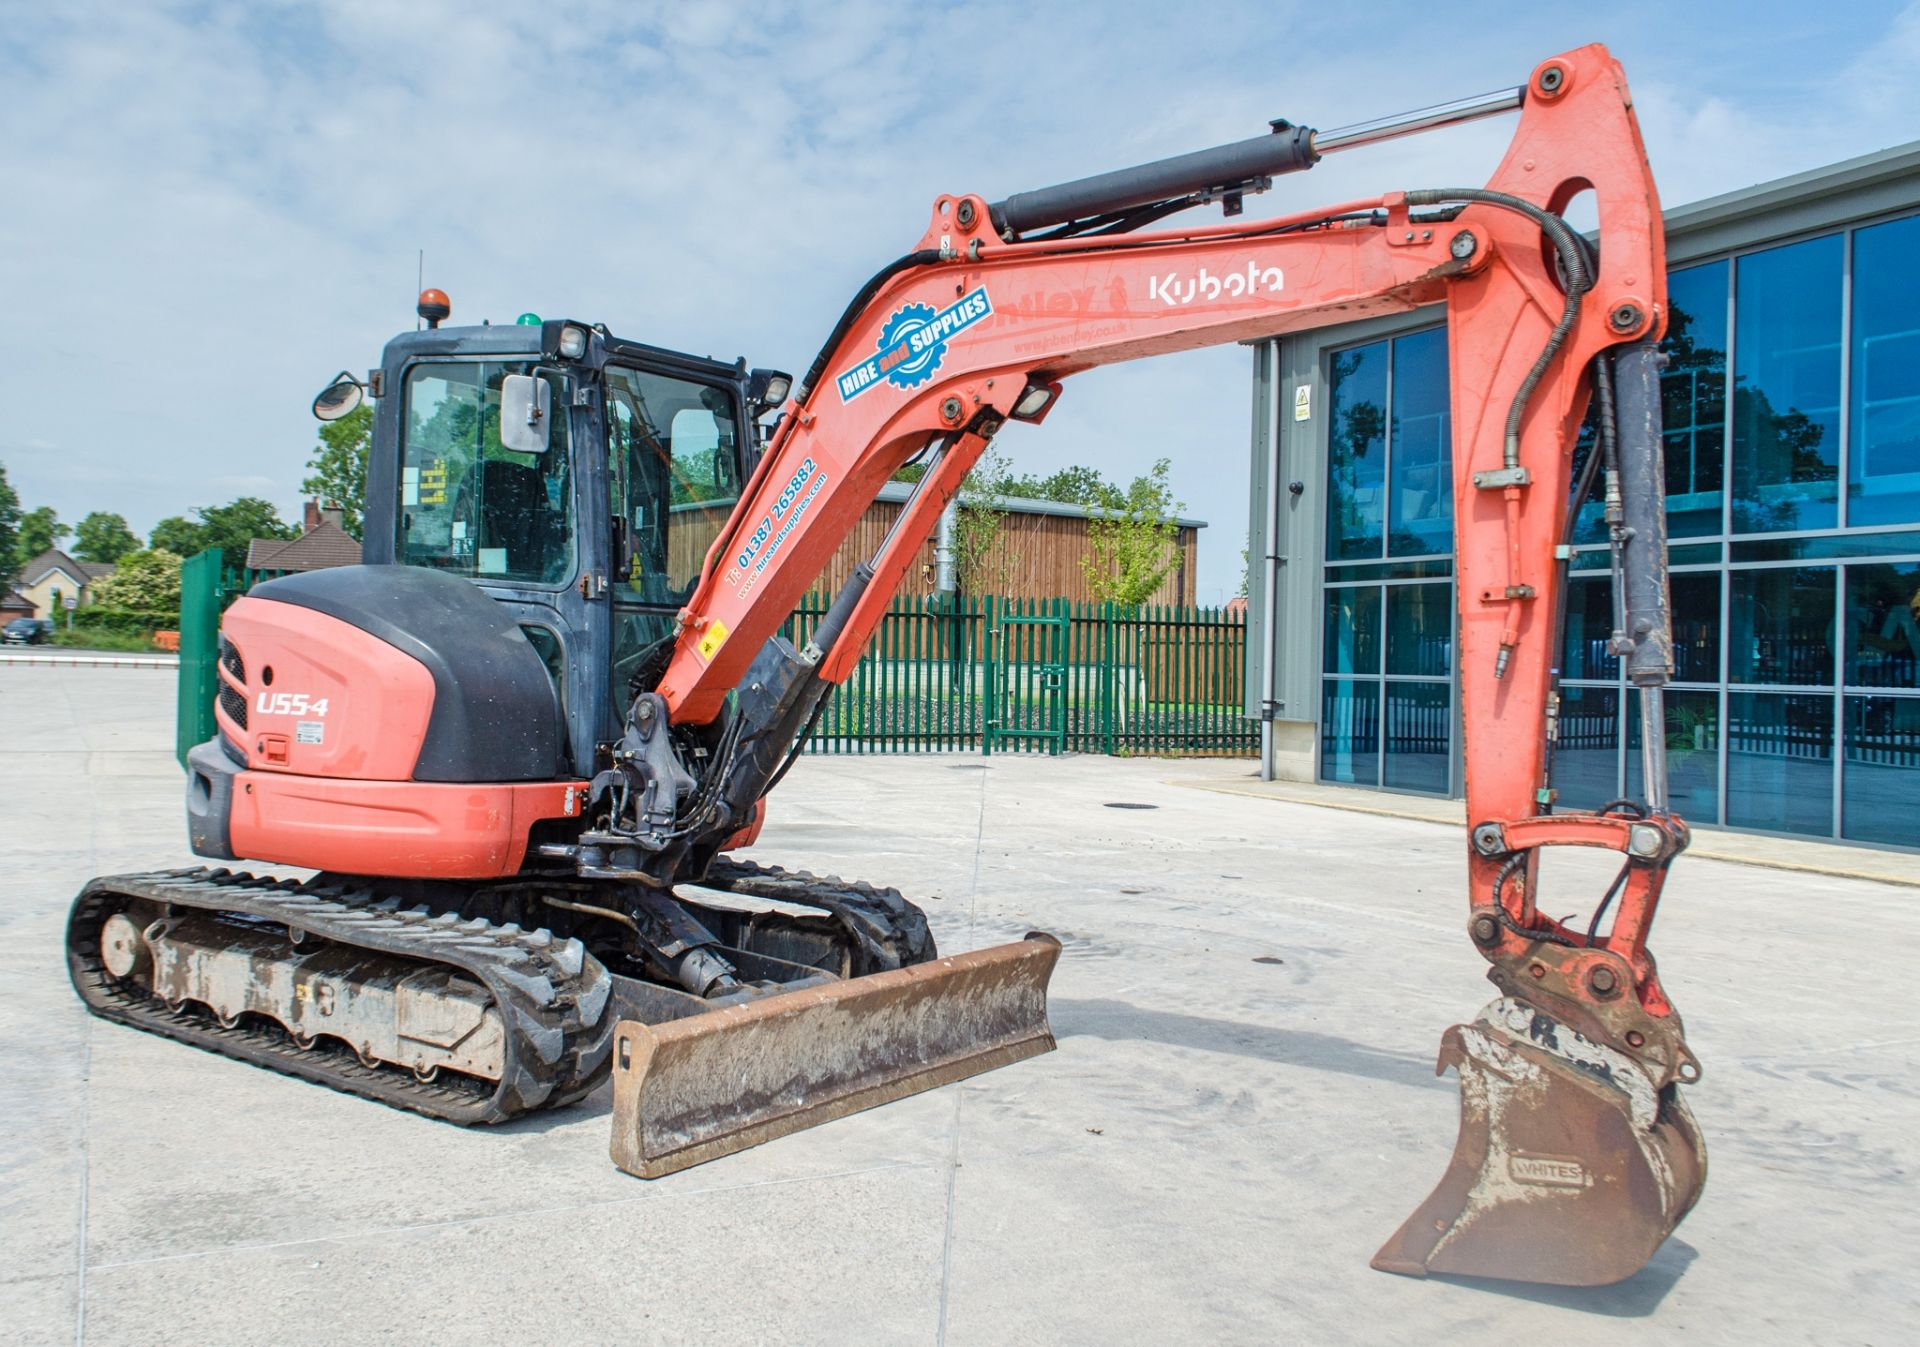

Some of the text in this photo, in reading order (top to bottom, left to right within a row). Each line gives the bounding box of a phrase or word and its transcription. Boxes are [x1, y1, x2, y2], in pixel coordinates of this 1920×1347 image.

[1150, 261, 1284, 306] Kubota
[841, 293, 987, 396] HIRE and SUPPLIES
[737, 516, 773, 568] 01387
[771, 457, 818, 520] 265882
[737, 472, 828, 600] www.hireandsupplies.com
[256, 692, 329, 717] U55-4
[1515, 1162, 1581, 1179] WHITES
